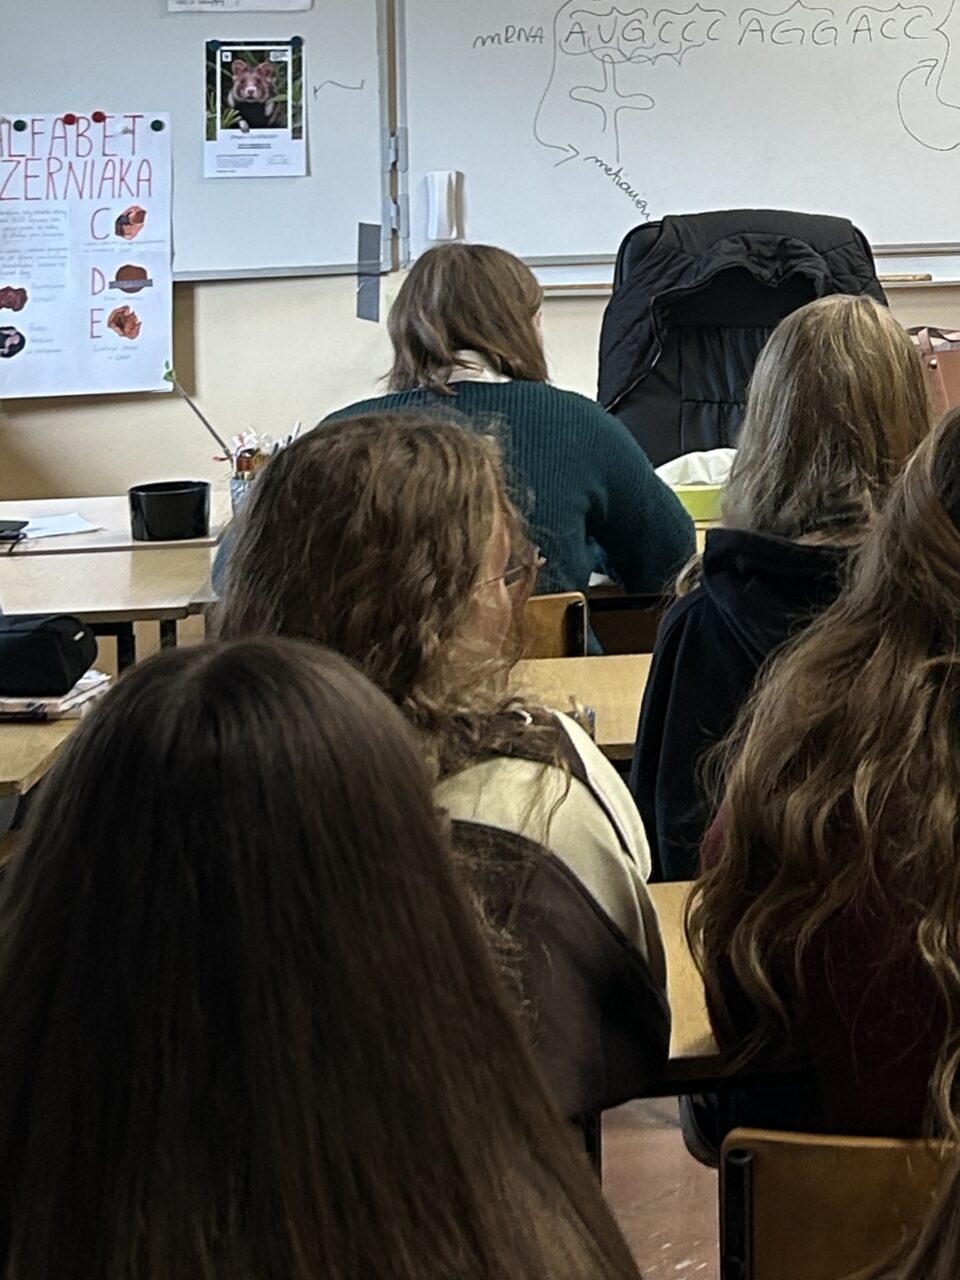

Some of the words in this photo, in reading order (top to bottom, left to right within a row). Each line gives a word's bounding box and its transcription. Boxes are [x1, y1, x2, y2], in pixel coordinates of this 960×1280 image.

[90, 207, 112, 240] C
[91, 267, 106, 296] D
[89, 308, 105, 339] E
